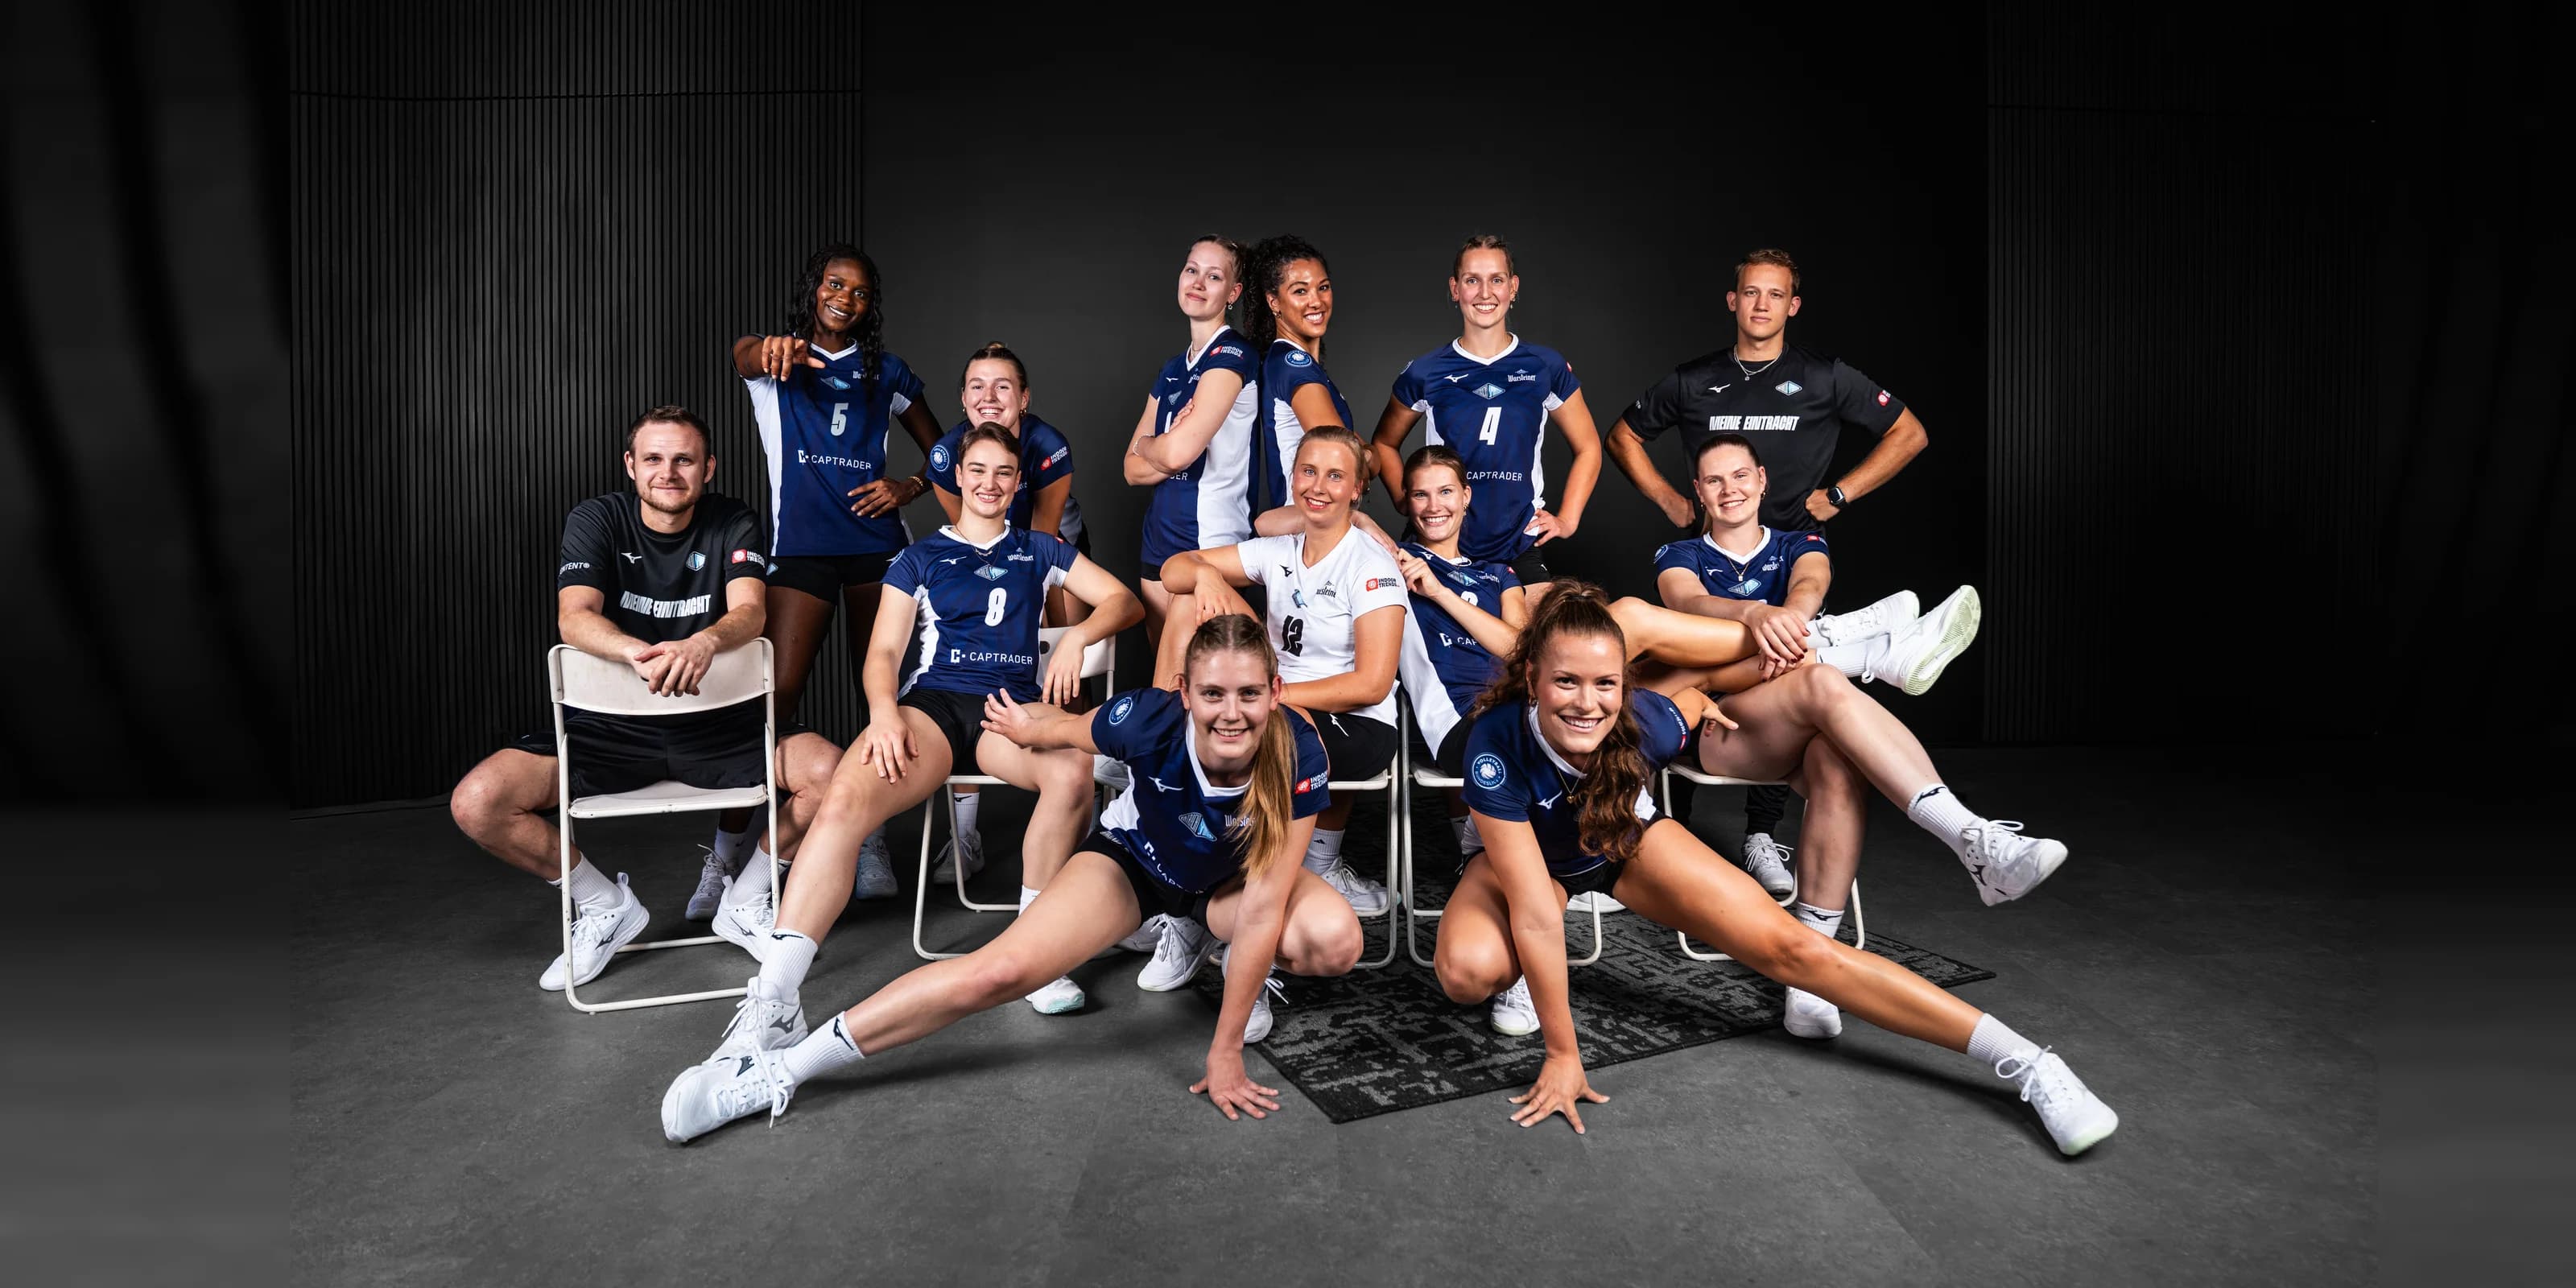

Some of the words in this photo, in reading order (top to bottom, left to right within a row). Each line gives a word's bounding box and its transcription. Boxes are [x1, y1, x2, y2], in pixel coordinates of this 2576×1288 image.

[830, 402, 848, 436] 5
[1480, 407, 1501, 445] 4
[1709, 415, 1742, 431] MEINE
[1743, 415, 1800, 431] EINTRACHT
[811, 455, 872, 469] CAPTRADER
[1466, 471, 1522, 481] CAPTRADER
[620, 591, 653, 615] MEINE
[653, 594, 711, 618] EINTRACHT
[985, 588, 1007, 626] 8
[1282, 615, 1304, 657] 12
[969, 651, 1033, 665] CAPTRADER
